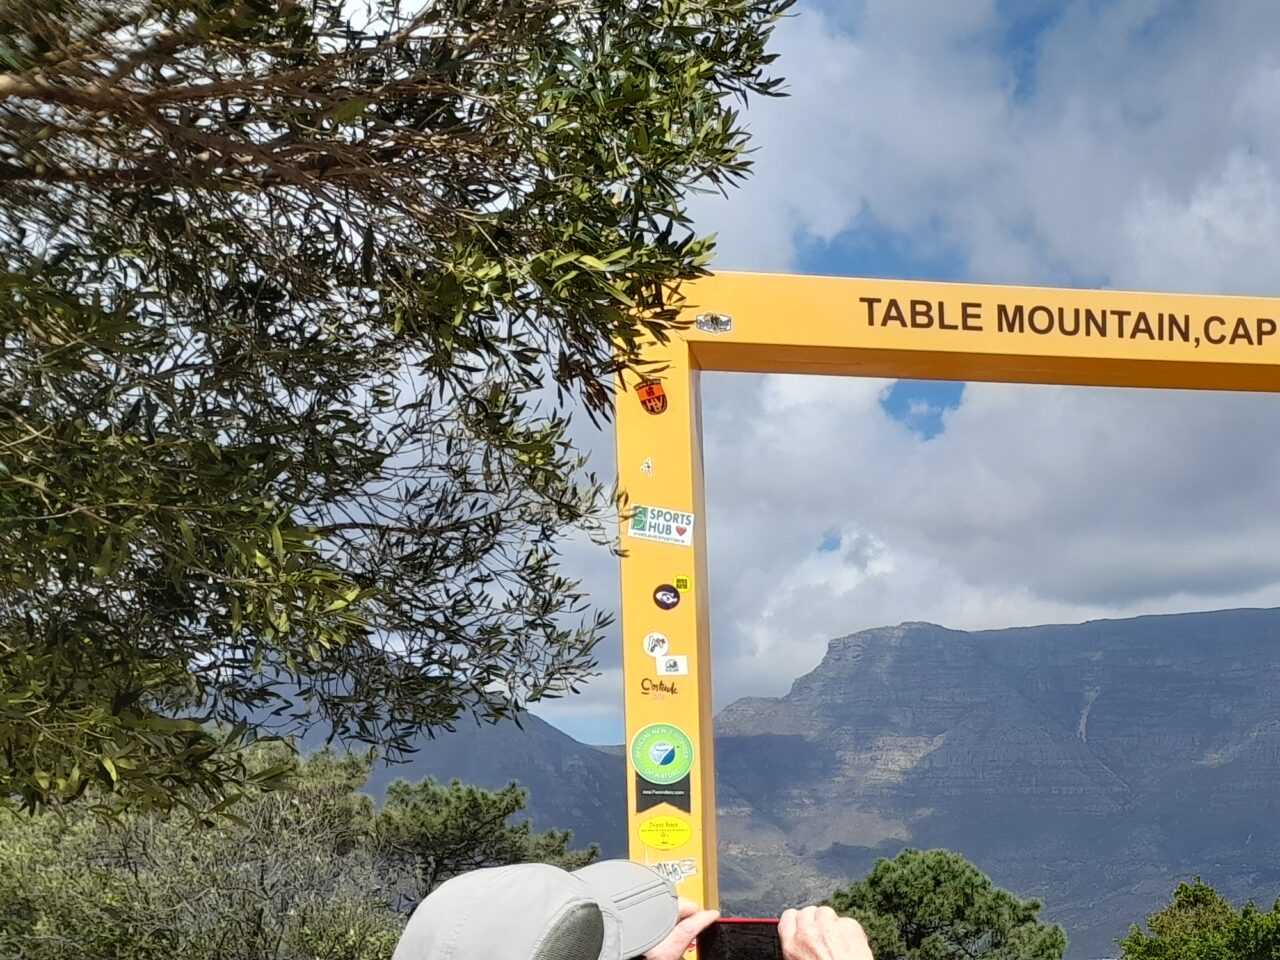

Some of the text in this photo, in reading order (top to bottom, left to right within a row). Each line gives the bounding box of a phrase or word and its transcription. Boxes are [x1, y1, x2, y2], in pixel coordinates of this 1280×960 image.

[859, 297, 984, 332] TABLE
[650, 508, 692, 526] SPORTS
[648, 521, 672, 536] HUB
[651, 727, 667, 736] NEW
